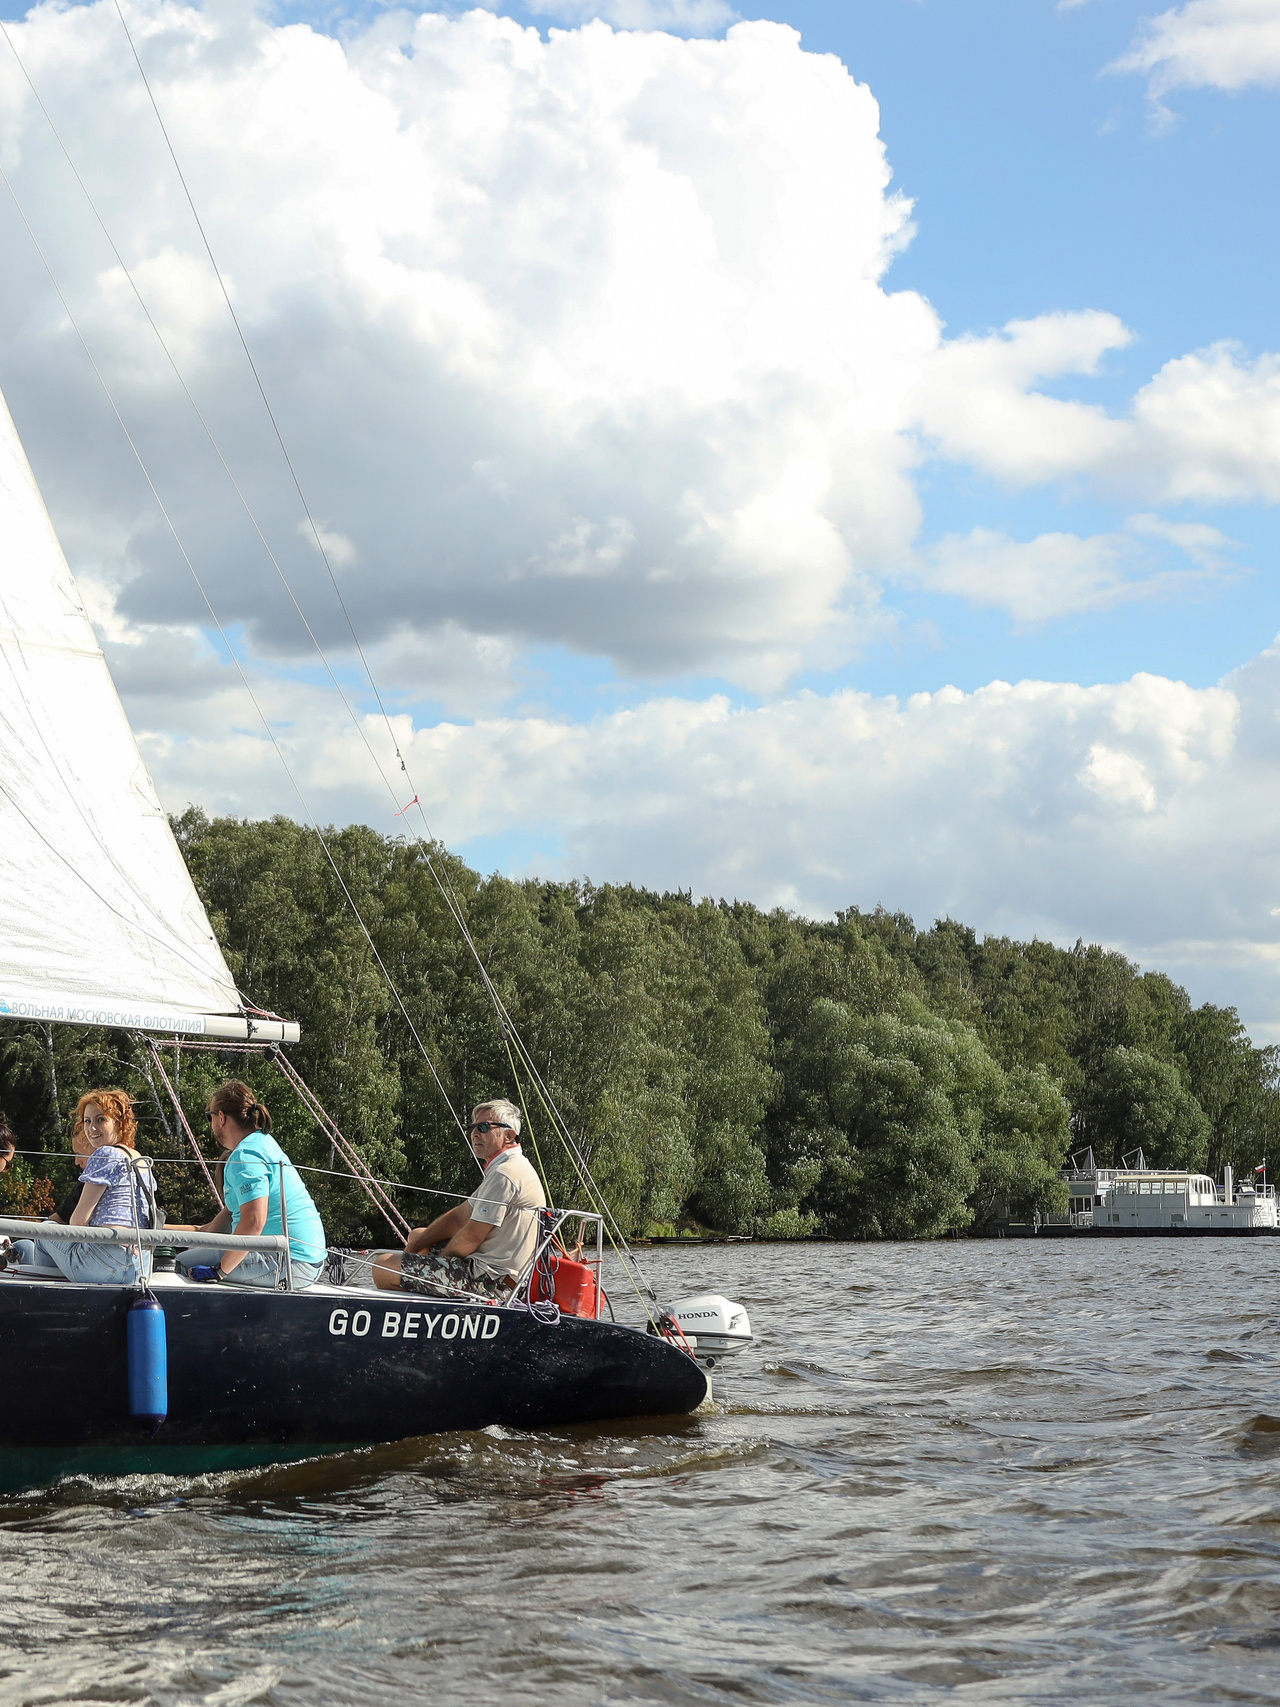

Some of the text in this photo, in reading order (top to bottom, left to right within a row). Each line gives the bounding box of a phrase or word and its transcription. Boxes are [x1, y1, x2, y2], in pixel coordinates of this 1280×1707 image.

[11, 1003, 202, 1034] ВОЛЬНАЯ МОСКОВСКАЯ ФЛОТИЛИЯ
[328, 1308, 501, 1340] GO BEYOND
[677, 1311, 719, 1320] HONDA
